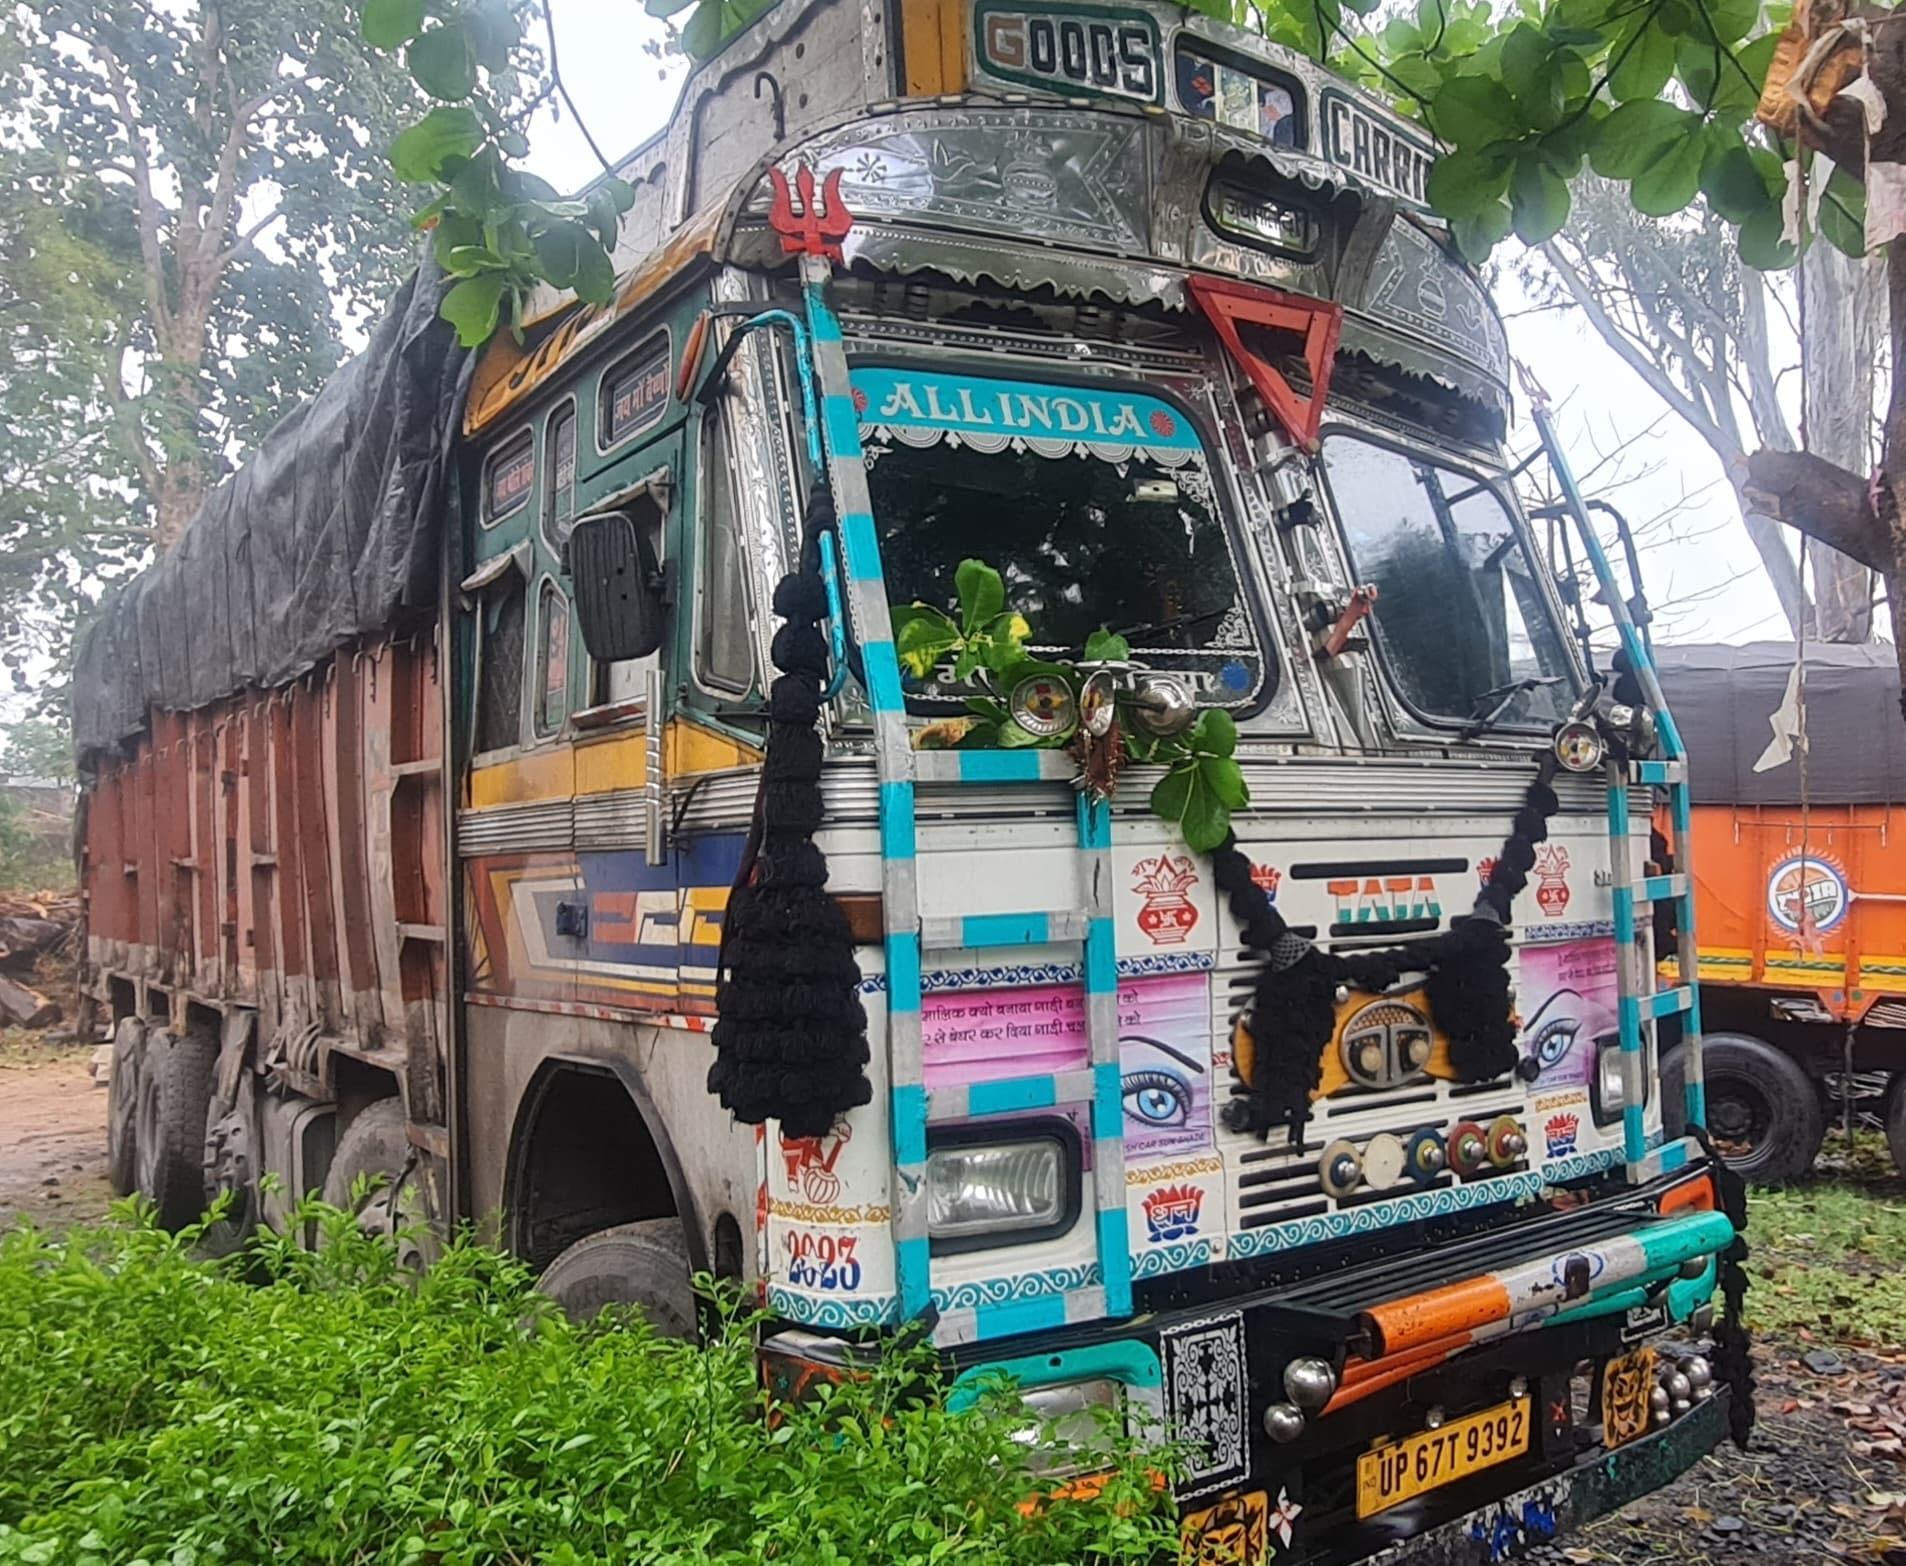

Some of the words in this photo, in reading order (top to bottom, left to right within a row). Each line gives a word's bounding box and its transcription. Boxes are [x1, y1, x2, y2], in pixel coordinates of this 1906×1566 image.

[987, 15, 1153, 96] GOODS
[1331, 101, 1433, 202] CARRI
[879, 382, 994, 425] ALL
[995, 392, 1148, 438] INDIA
[1327, 876, 1442, 921] TATA
[787, 1229, 861, 1291] 2023
[1380, 1452, 1408, 1497] UP
[1415, 1432, 1460, 1482] 67T
[1466, 1411, 1523, 1462] 9392
